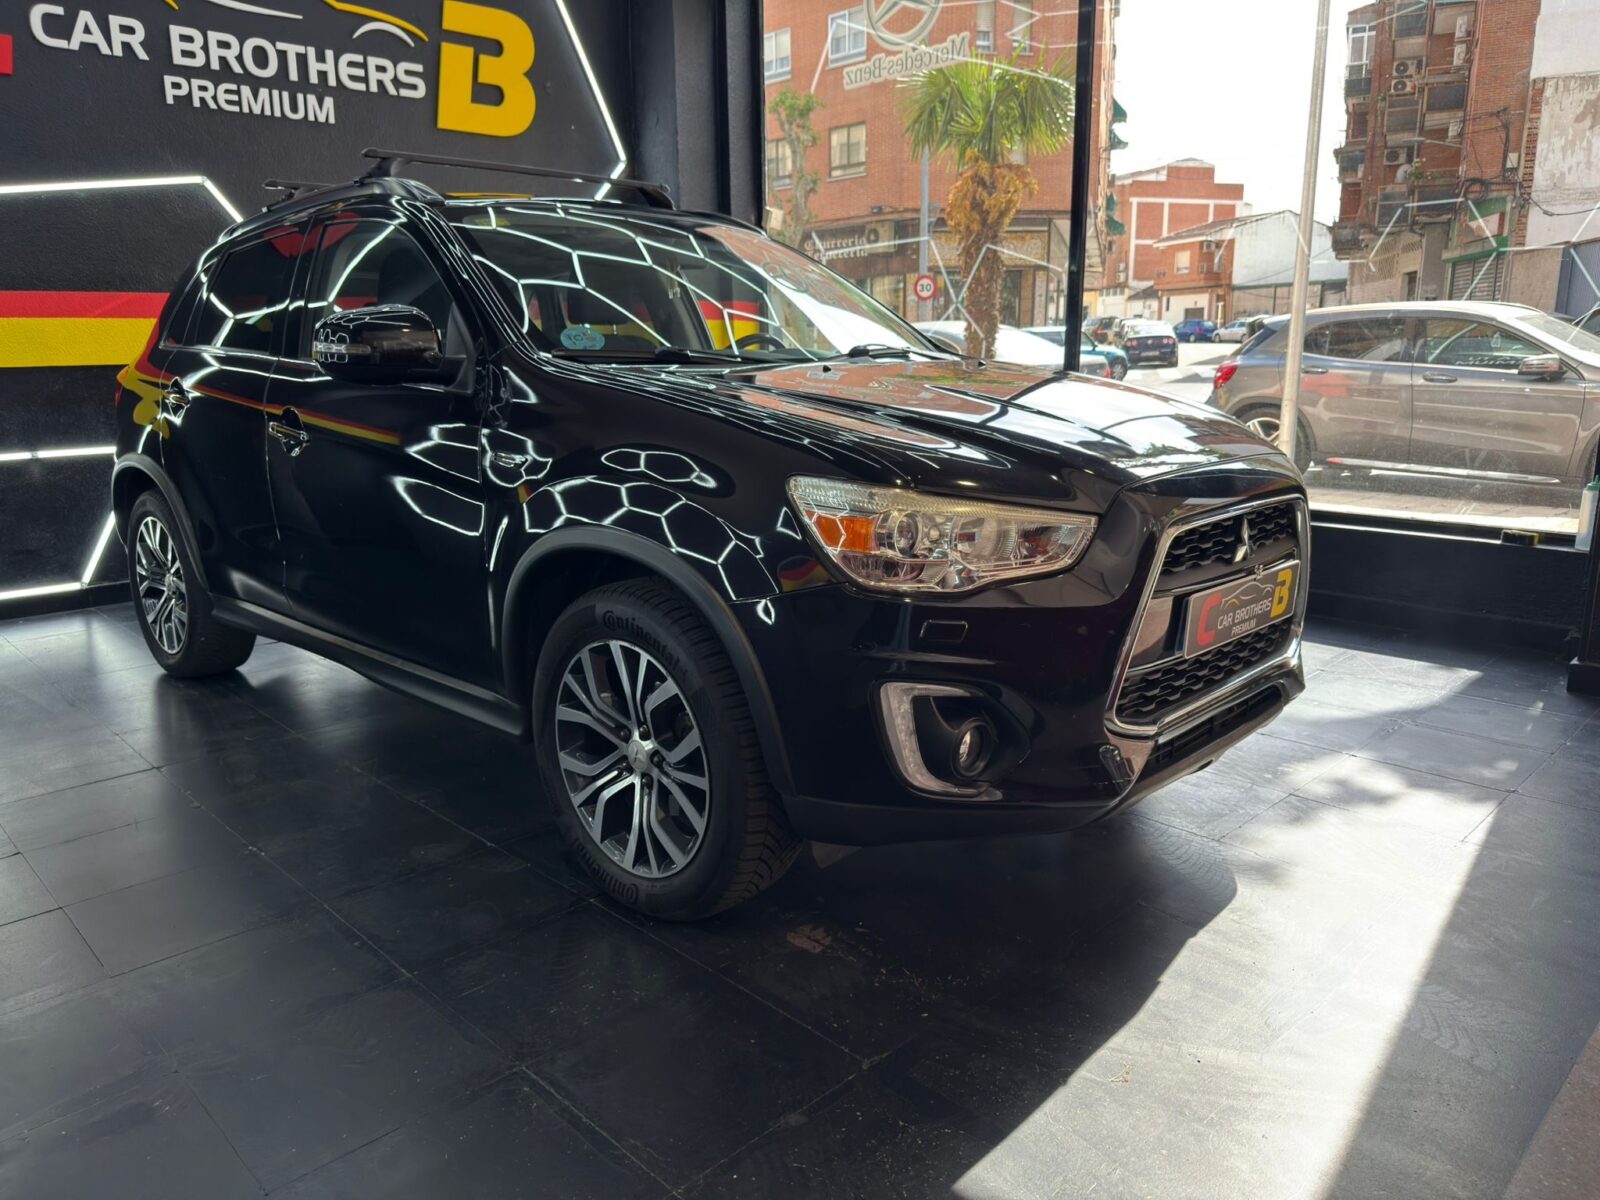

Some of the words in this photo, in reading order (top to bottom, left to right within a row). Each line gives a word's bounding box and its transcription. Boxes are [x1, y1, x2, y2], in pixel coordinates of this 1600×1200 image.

[29, 3, 149, 60] CAR
[168, 24, 426, 99] BROTHERS
[163, 74, 336, 125] PREMIUM
[918, 282, 932, 293] 30
[1217, 610, 1233, 630] CAR
[1235, 597, 1272, 621] BROTHERS
[1270, 568, 1293, 618] B
[603, 609, 680, 670] Continental
[1196, 591, 1222, 646] C
[1231, 618, 1256, 636] PREMIUM
